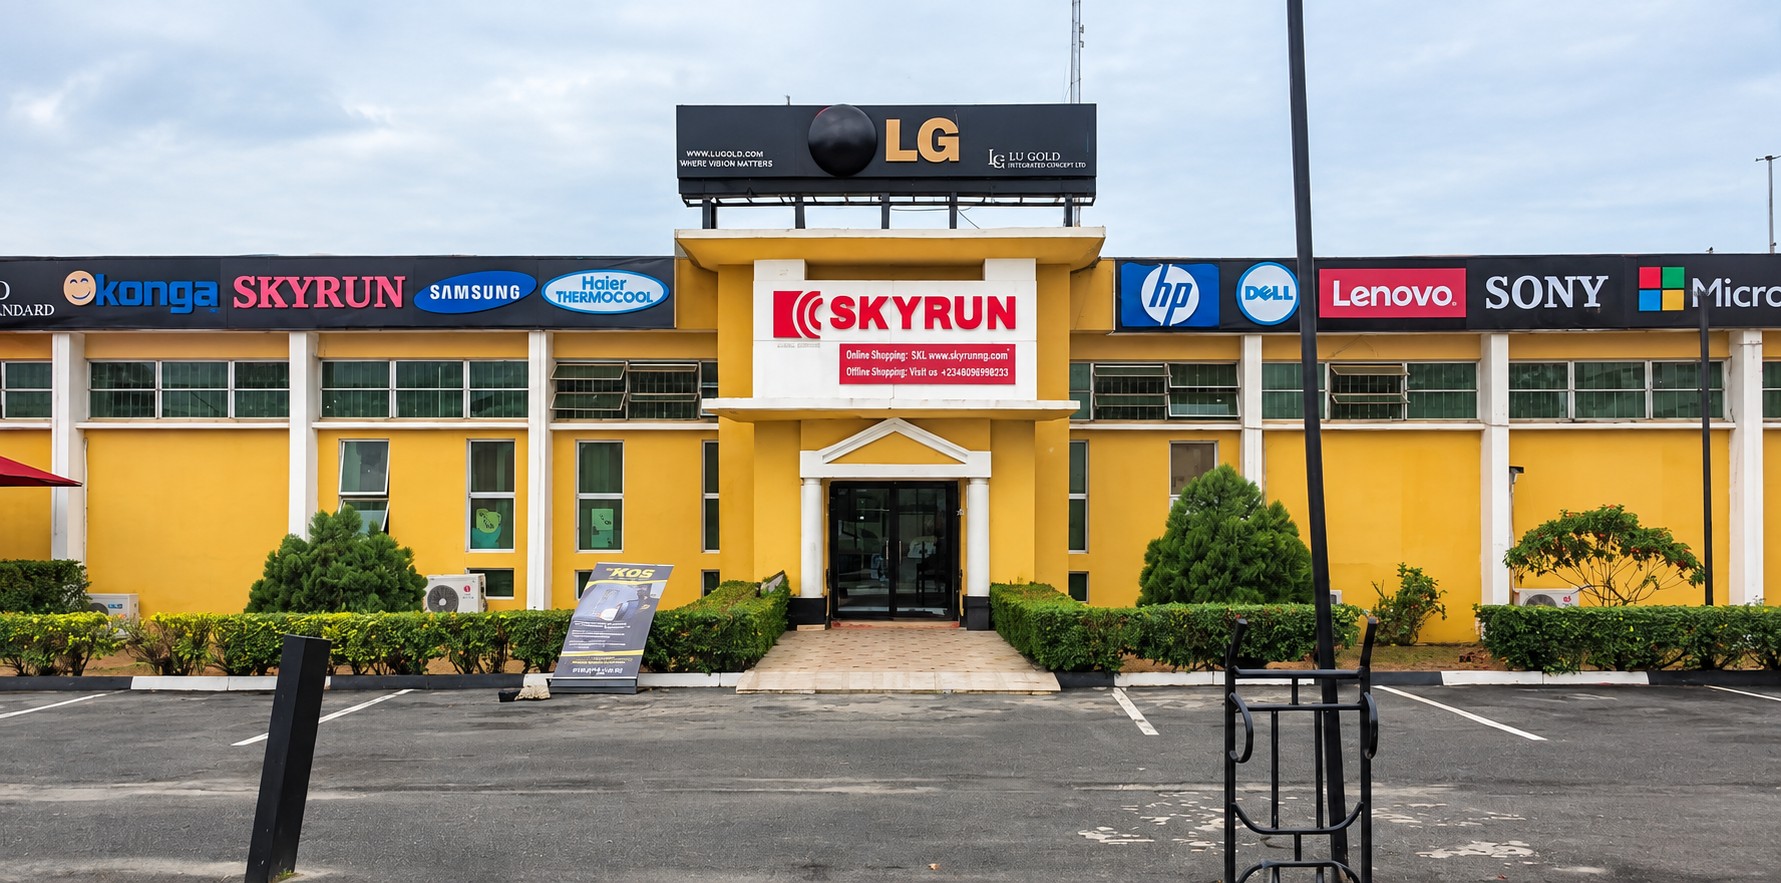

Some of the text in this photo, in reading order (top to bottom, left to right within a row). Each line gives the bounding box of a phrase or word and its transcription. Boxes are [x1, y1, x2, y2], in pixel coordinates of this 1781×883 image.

[885, 117, 960, 162] LG
[680, 159, 707, 168] WHERE
[737, 160, 773, 168] MATTERS
[1009, 152, 1061, 162] LU GOLD
[581, 275, 627, 291] Haier
[95, 274, 218, 314] konga
[233, 275, 406, 309] SKYRUN
[429, 284, 521, 300] SAMSUNG
[555, 291, 654, 304] THERMOCOOL
[1149, 264, 1192, 326] hp
[1245, 285, 1294, 302] DELL
[1333, 280, 1453, 307] Lenovo
[1485, 275, 1609, 310] SONY
[1692, 277, 1781, 308] Micro
[0, 304, 55, 317] NDARD
[829, 295, 1016, 331] SKYRUN
[846, 350, 870, 360] Online
[871, 350, 908, 362] Shopping:
[871, 367, 907, 378] Shopping:
